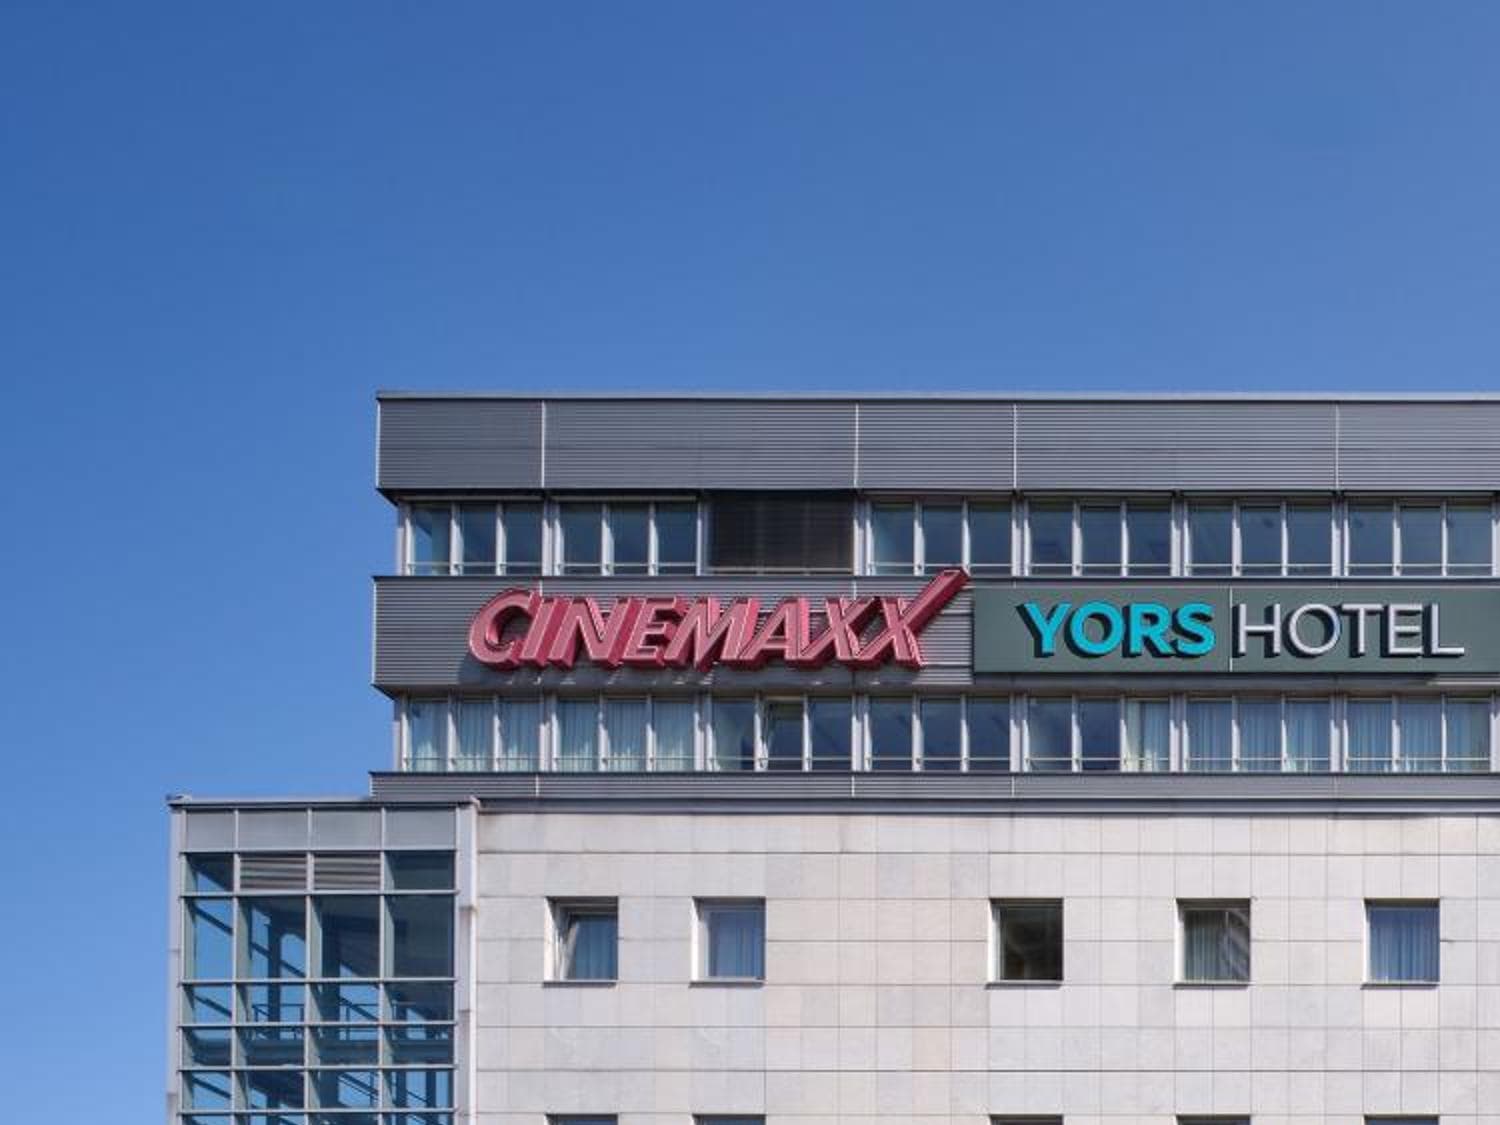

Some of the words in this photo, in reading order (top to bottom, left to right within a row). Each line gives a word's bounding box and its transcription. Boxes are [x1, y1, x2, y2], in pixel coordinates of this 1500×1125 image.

[468, 566, 969, 672] CINEMAXX
[1017, 601, 1217, 657] YORS
[1232, 602, 1466, 657] HOTEL
